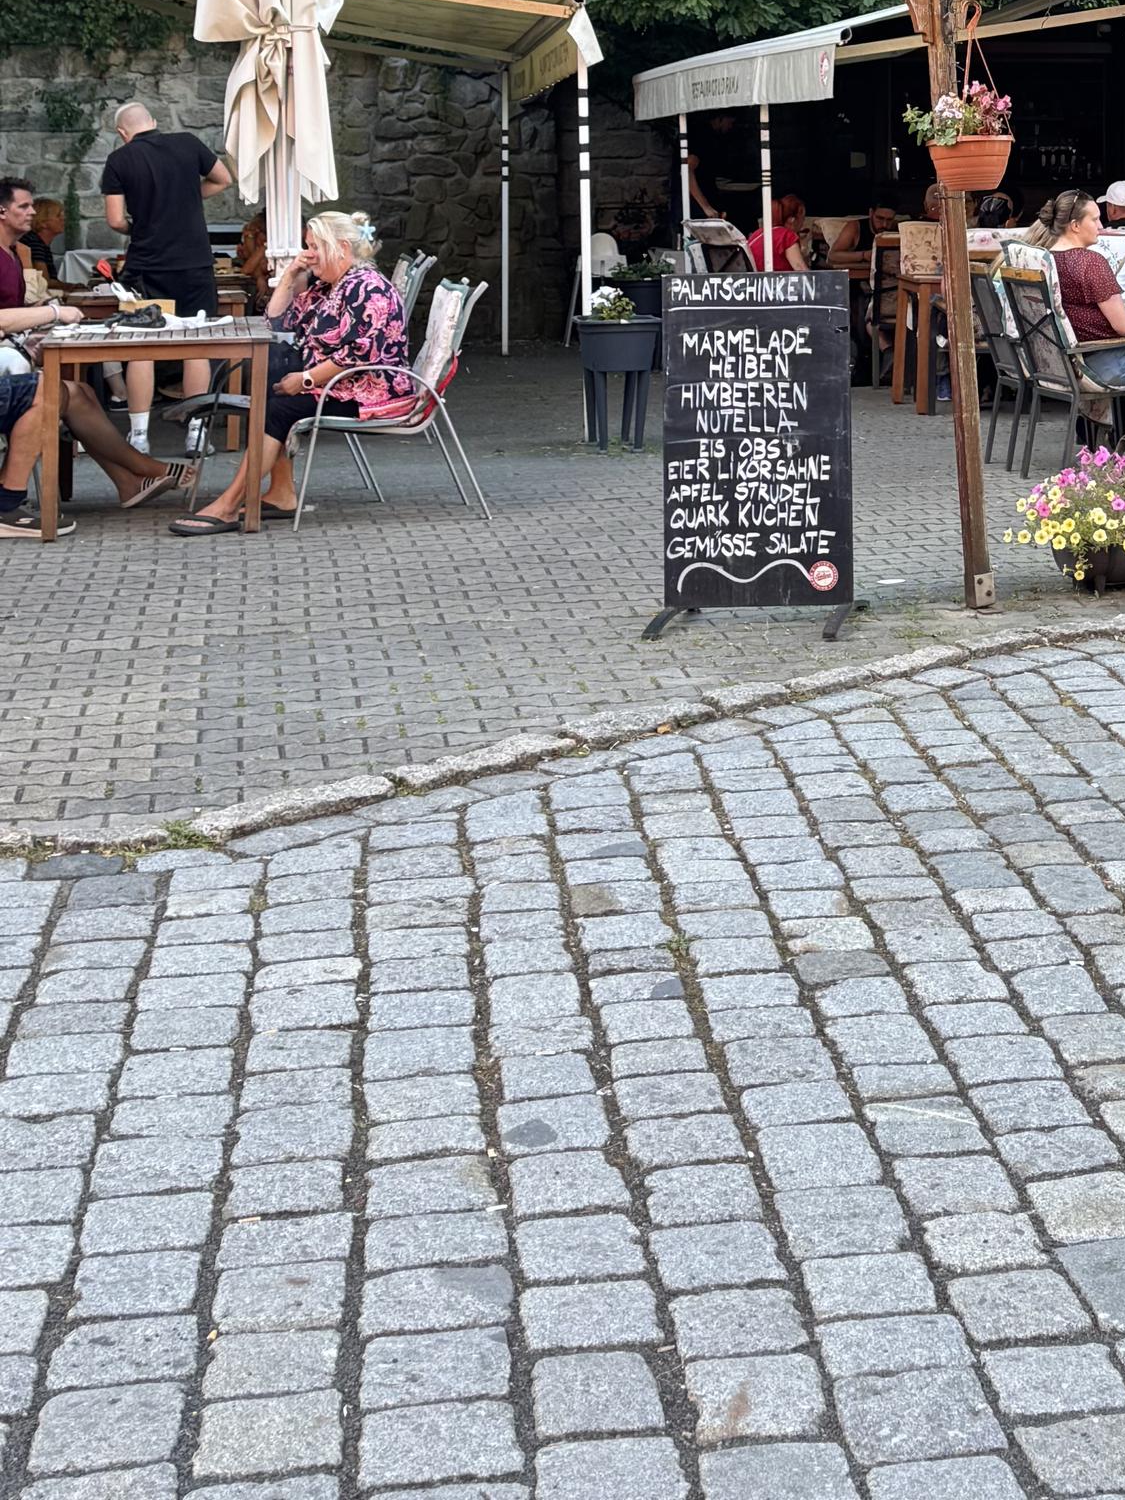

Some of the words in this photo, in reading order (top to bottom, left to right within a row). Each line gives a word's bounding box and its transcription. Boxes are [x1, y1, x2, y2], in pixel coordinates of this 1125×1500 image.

[671, 275, 816, 303] PALATSCHINKEN
[682, 326, 812, 357] MARMELADE
[680, 380, 807, 411] HIMBEEREN
[696, 408, 799, 434] NUTELLA
[738, 437, 801, 461] OBST
[667, 458, 710, 481] EIER
[734, 481, 821, 505] STRUDEL
[670, 501, 730, 529] QUARK
[738, 501, 820, 528] KUCHEN
[666, 530, 760, 560] GEMÜSSE
[765, 529, 836, 555] SALATE
